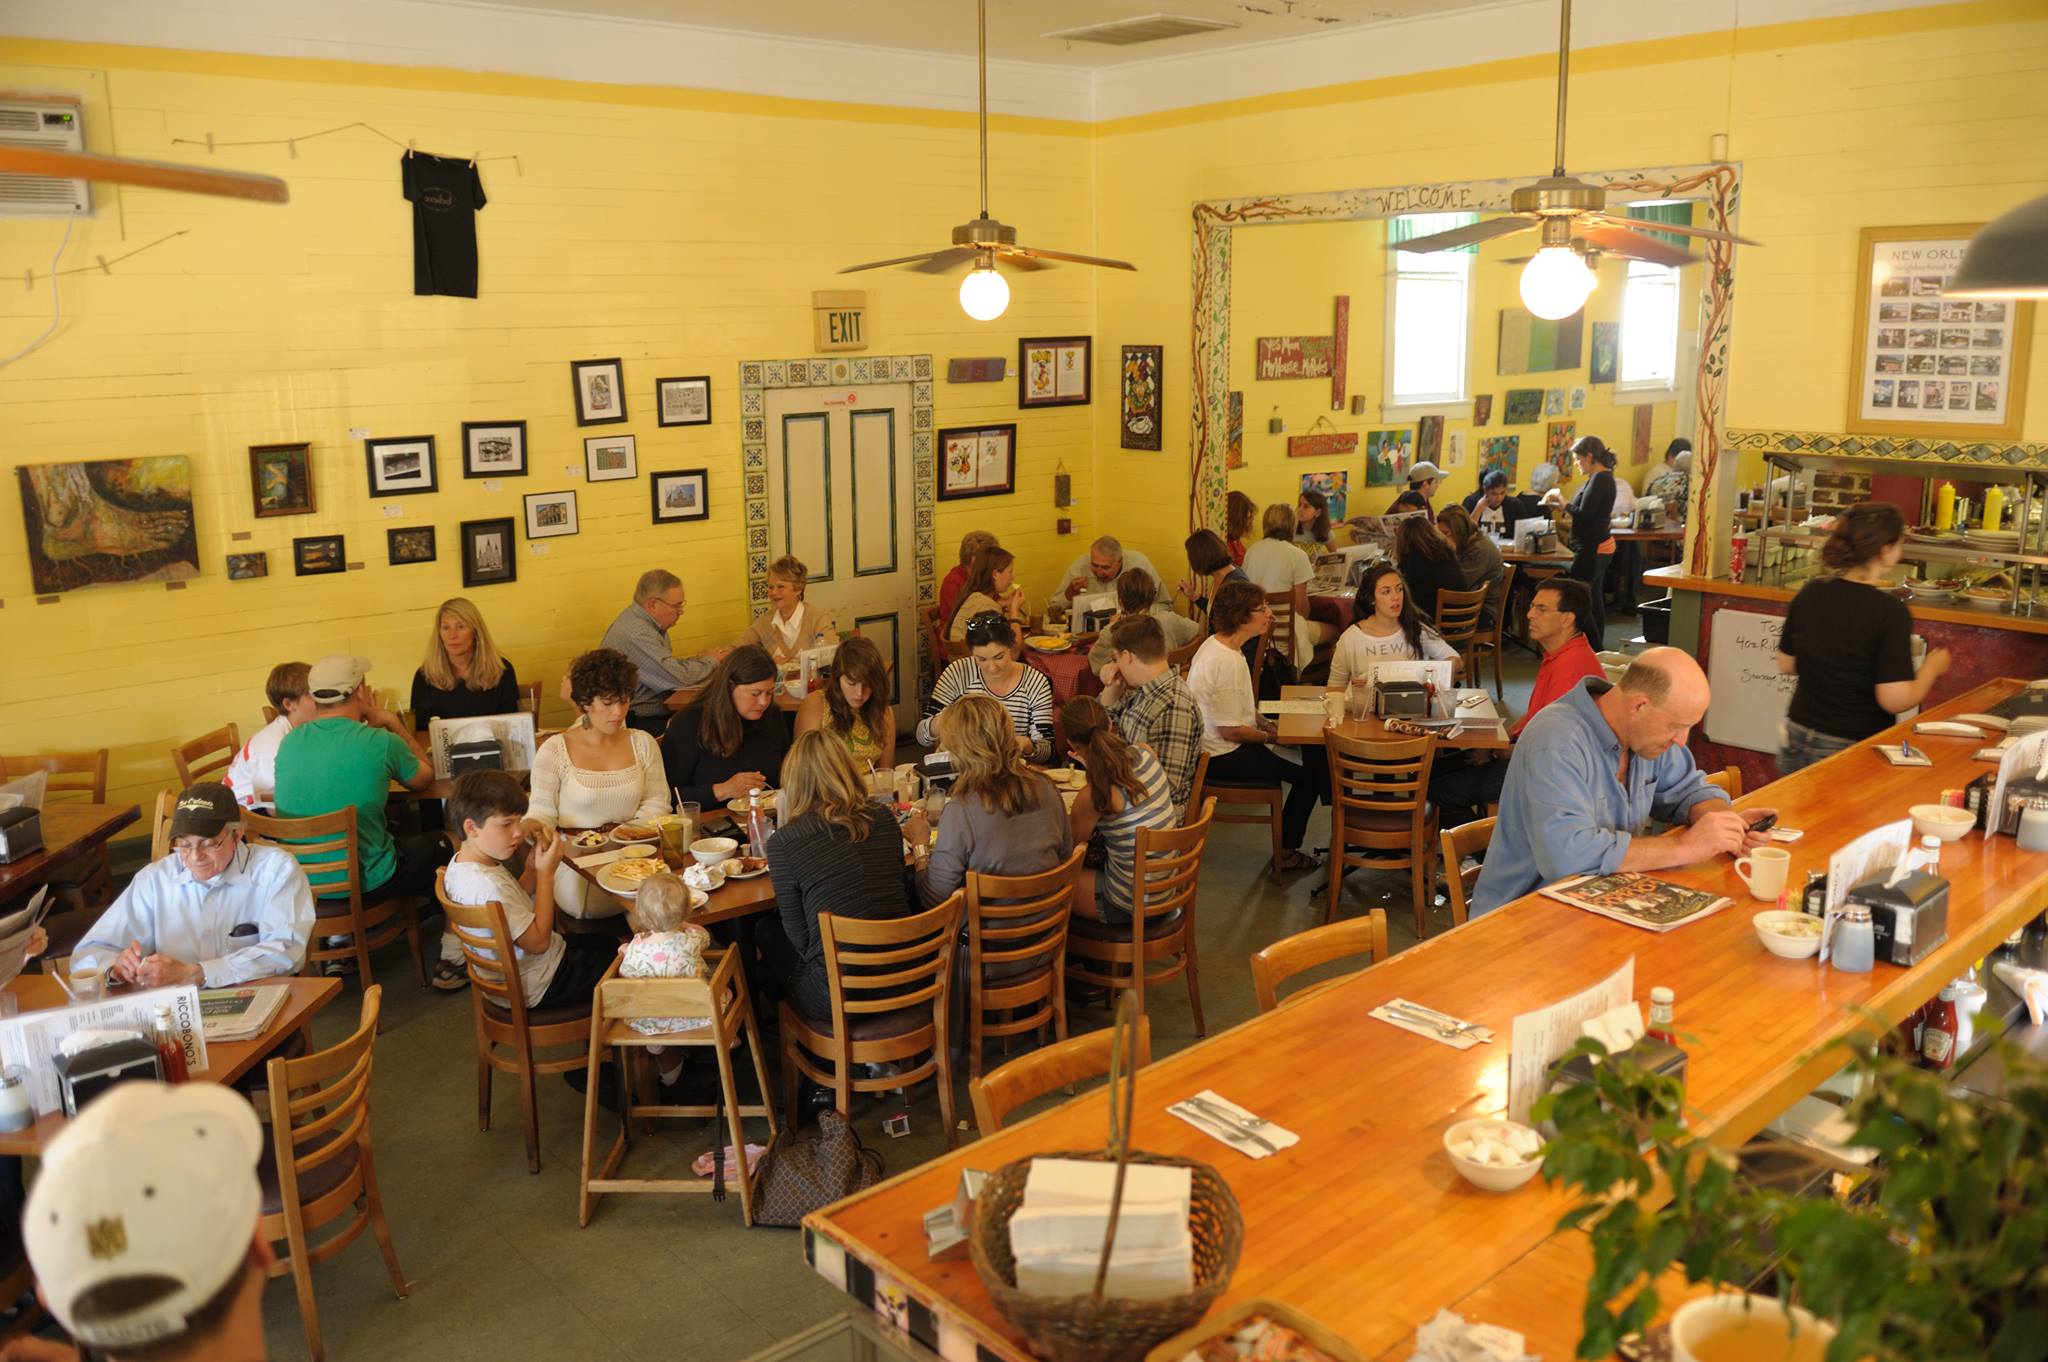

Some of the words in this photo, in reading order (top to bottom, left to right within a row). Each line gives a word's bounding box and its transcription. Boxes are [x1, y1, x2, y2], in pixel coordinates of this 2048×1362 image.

[1375, 184, 1476, 213] WELCOME
[1892, 249, 1922, 261] NEW
[1926, 248, 1968, 261] ORLE
[829, 311, 861, 343] EXIT
[1365, 642, 1404, 657] NEW
[177, 994, 197, 1067] RICCOBONO'S
